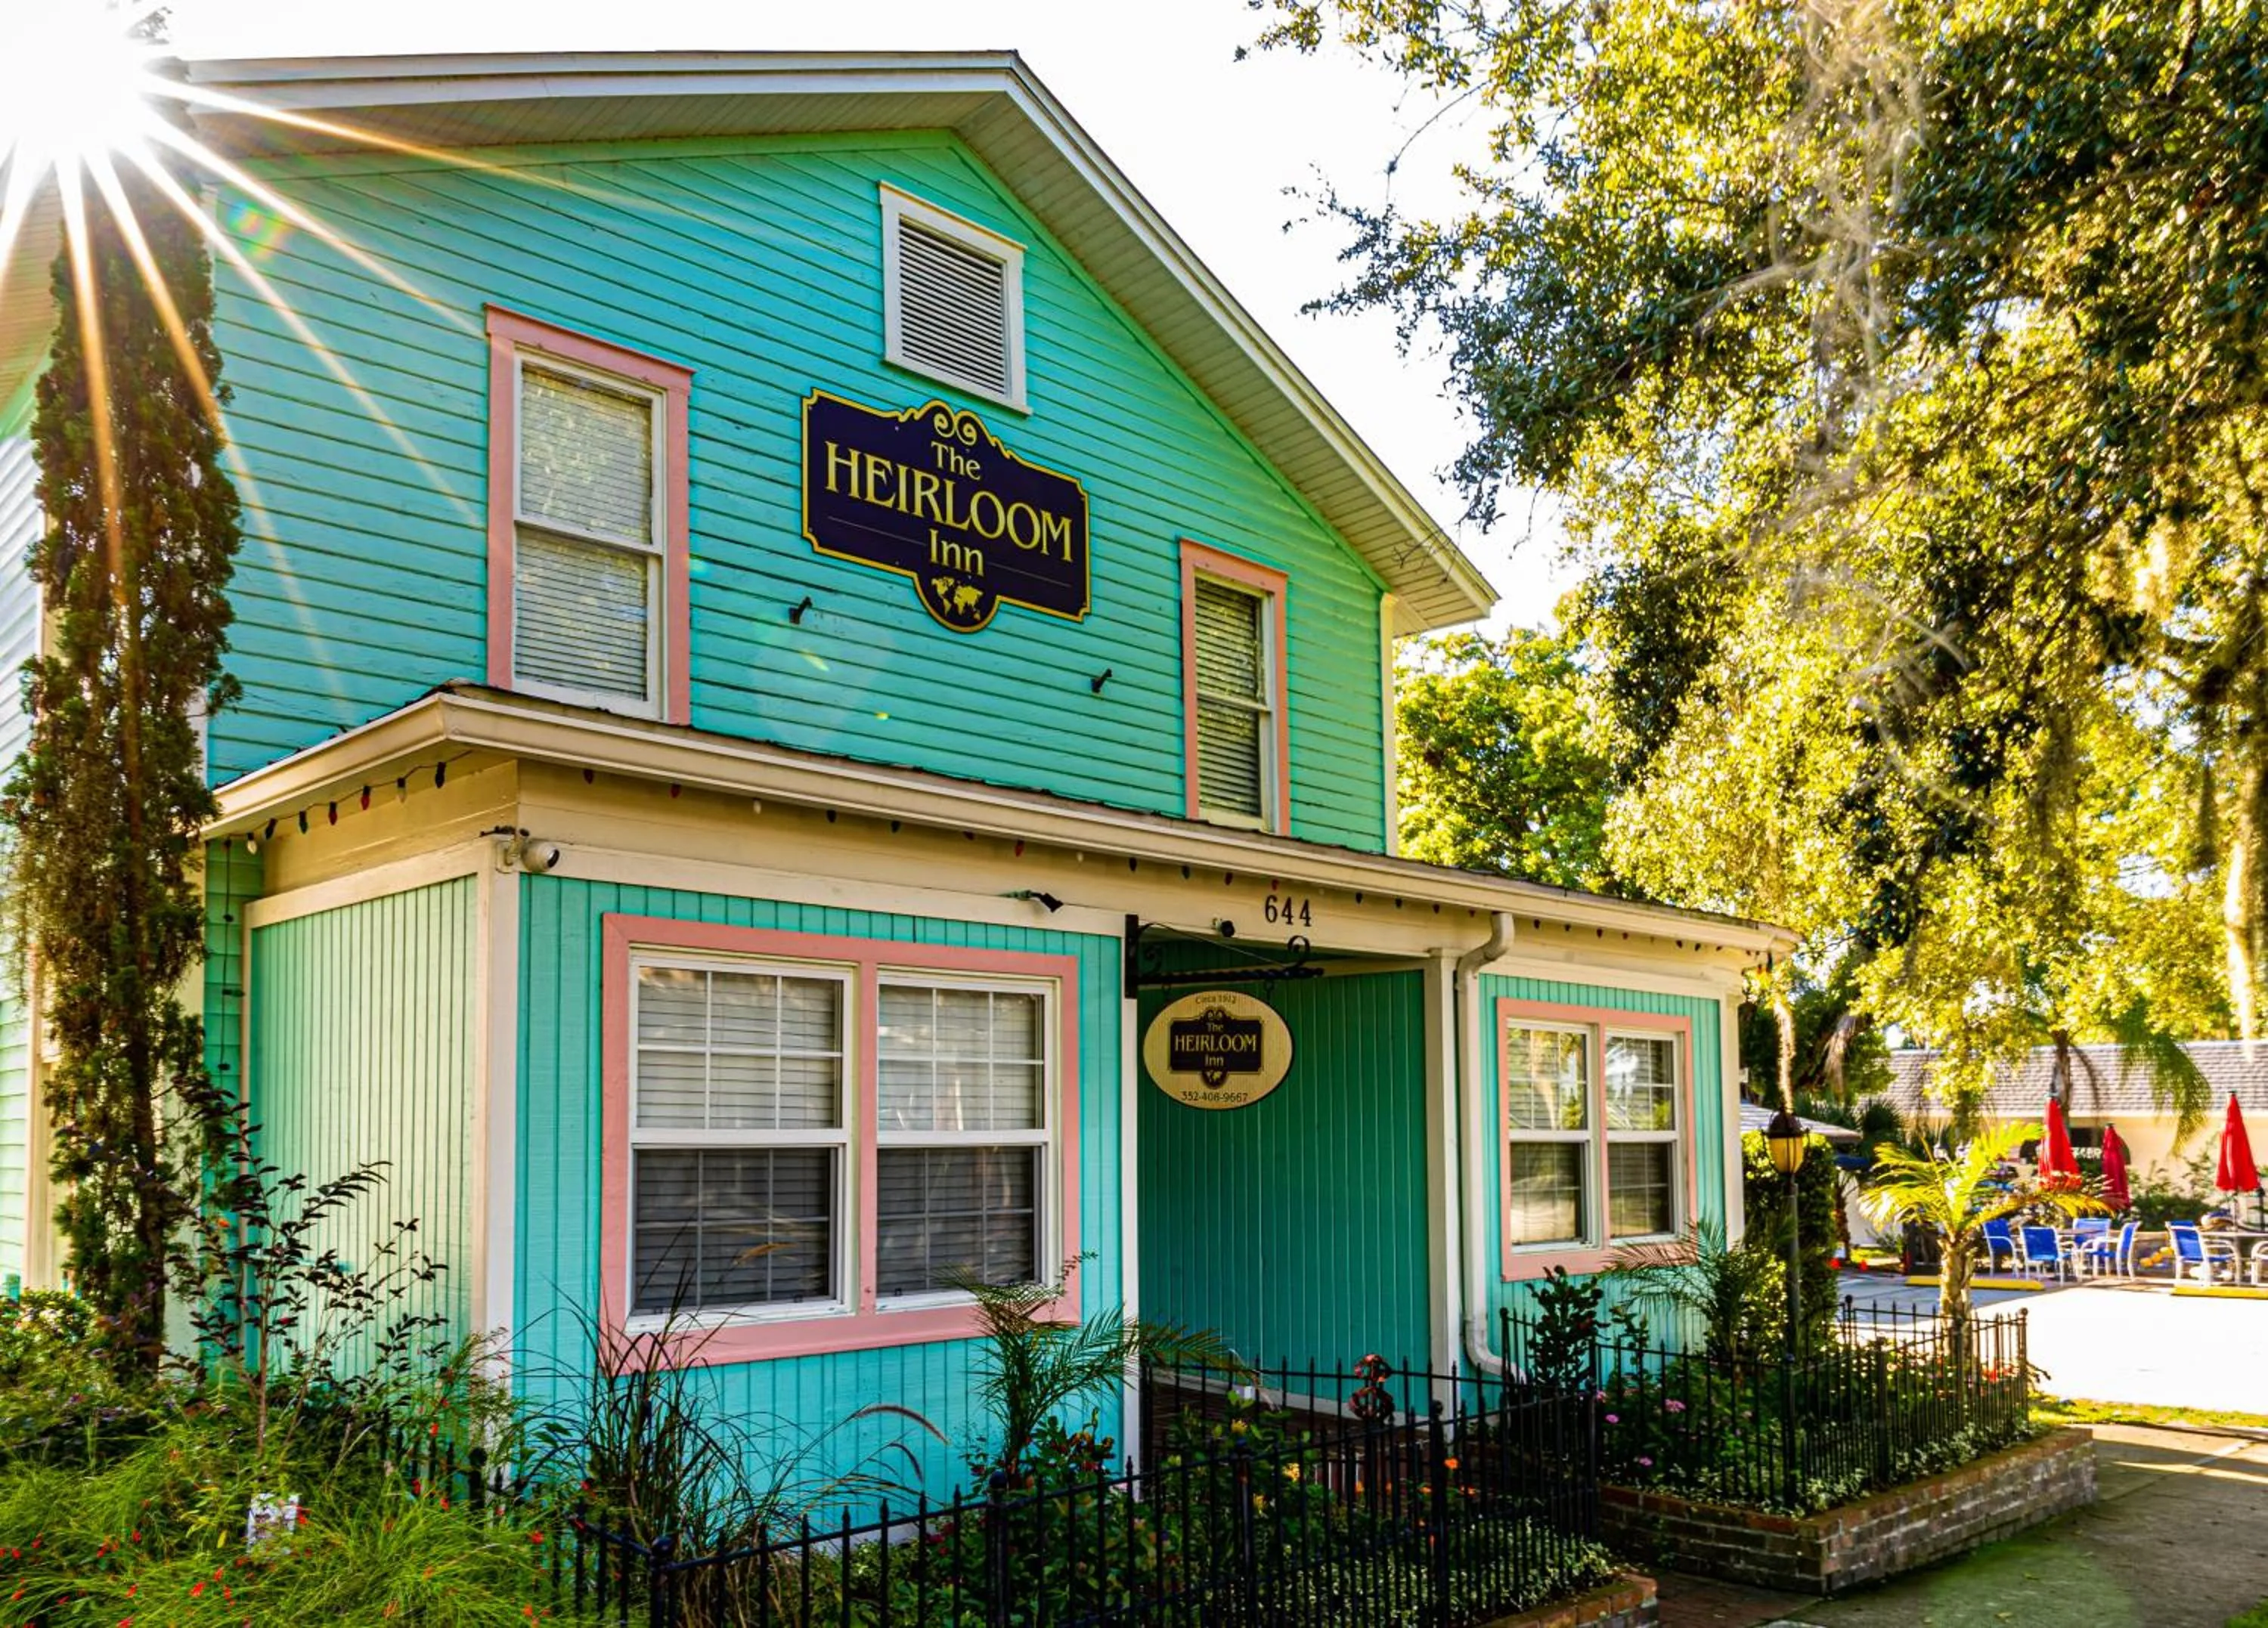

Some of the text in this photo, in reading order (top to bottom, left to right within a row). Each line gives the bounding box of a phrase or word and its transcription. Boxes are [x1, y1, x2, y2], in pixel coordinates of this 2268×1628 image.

[931, 441, 981, 480] The
[825, 441, 1074, 563] HEIRLOOM
[928, 528, 984, 577] Inn
[1265, 895, 1311, 927] 644
[1174, 1034, 1256, 1052] HEIRLOOM
[1207, 1022, 1224, 1032] The
[1204, 1054, 1224, 1067] Inn
